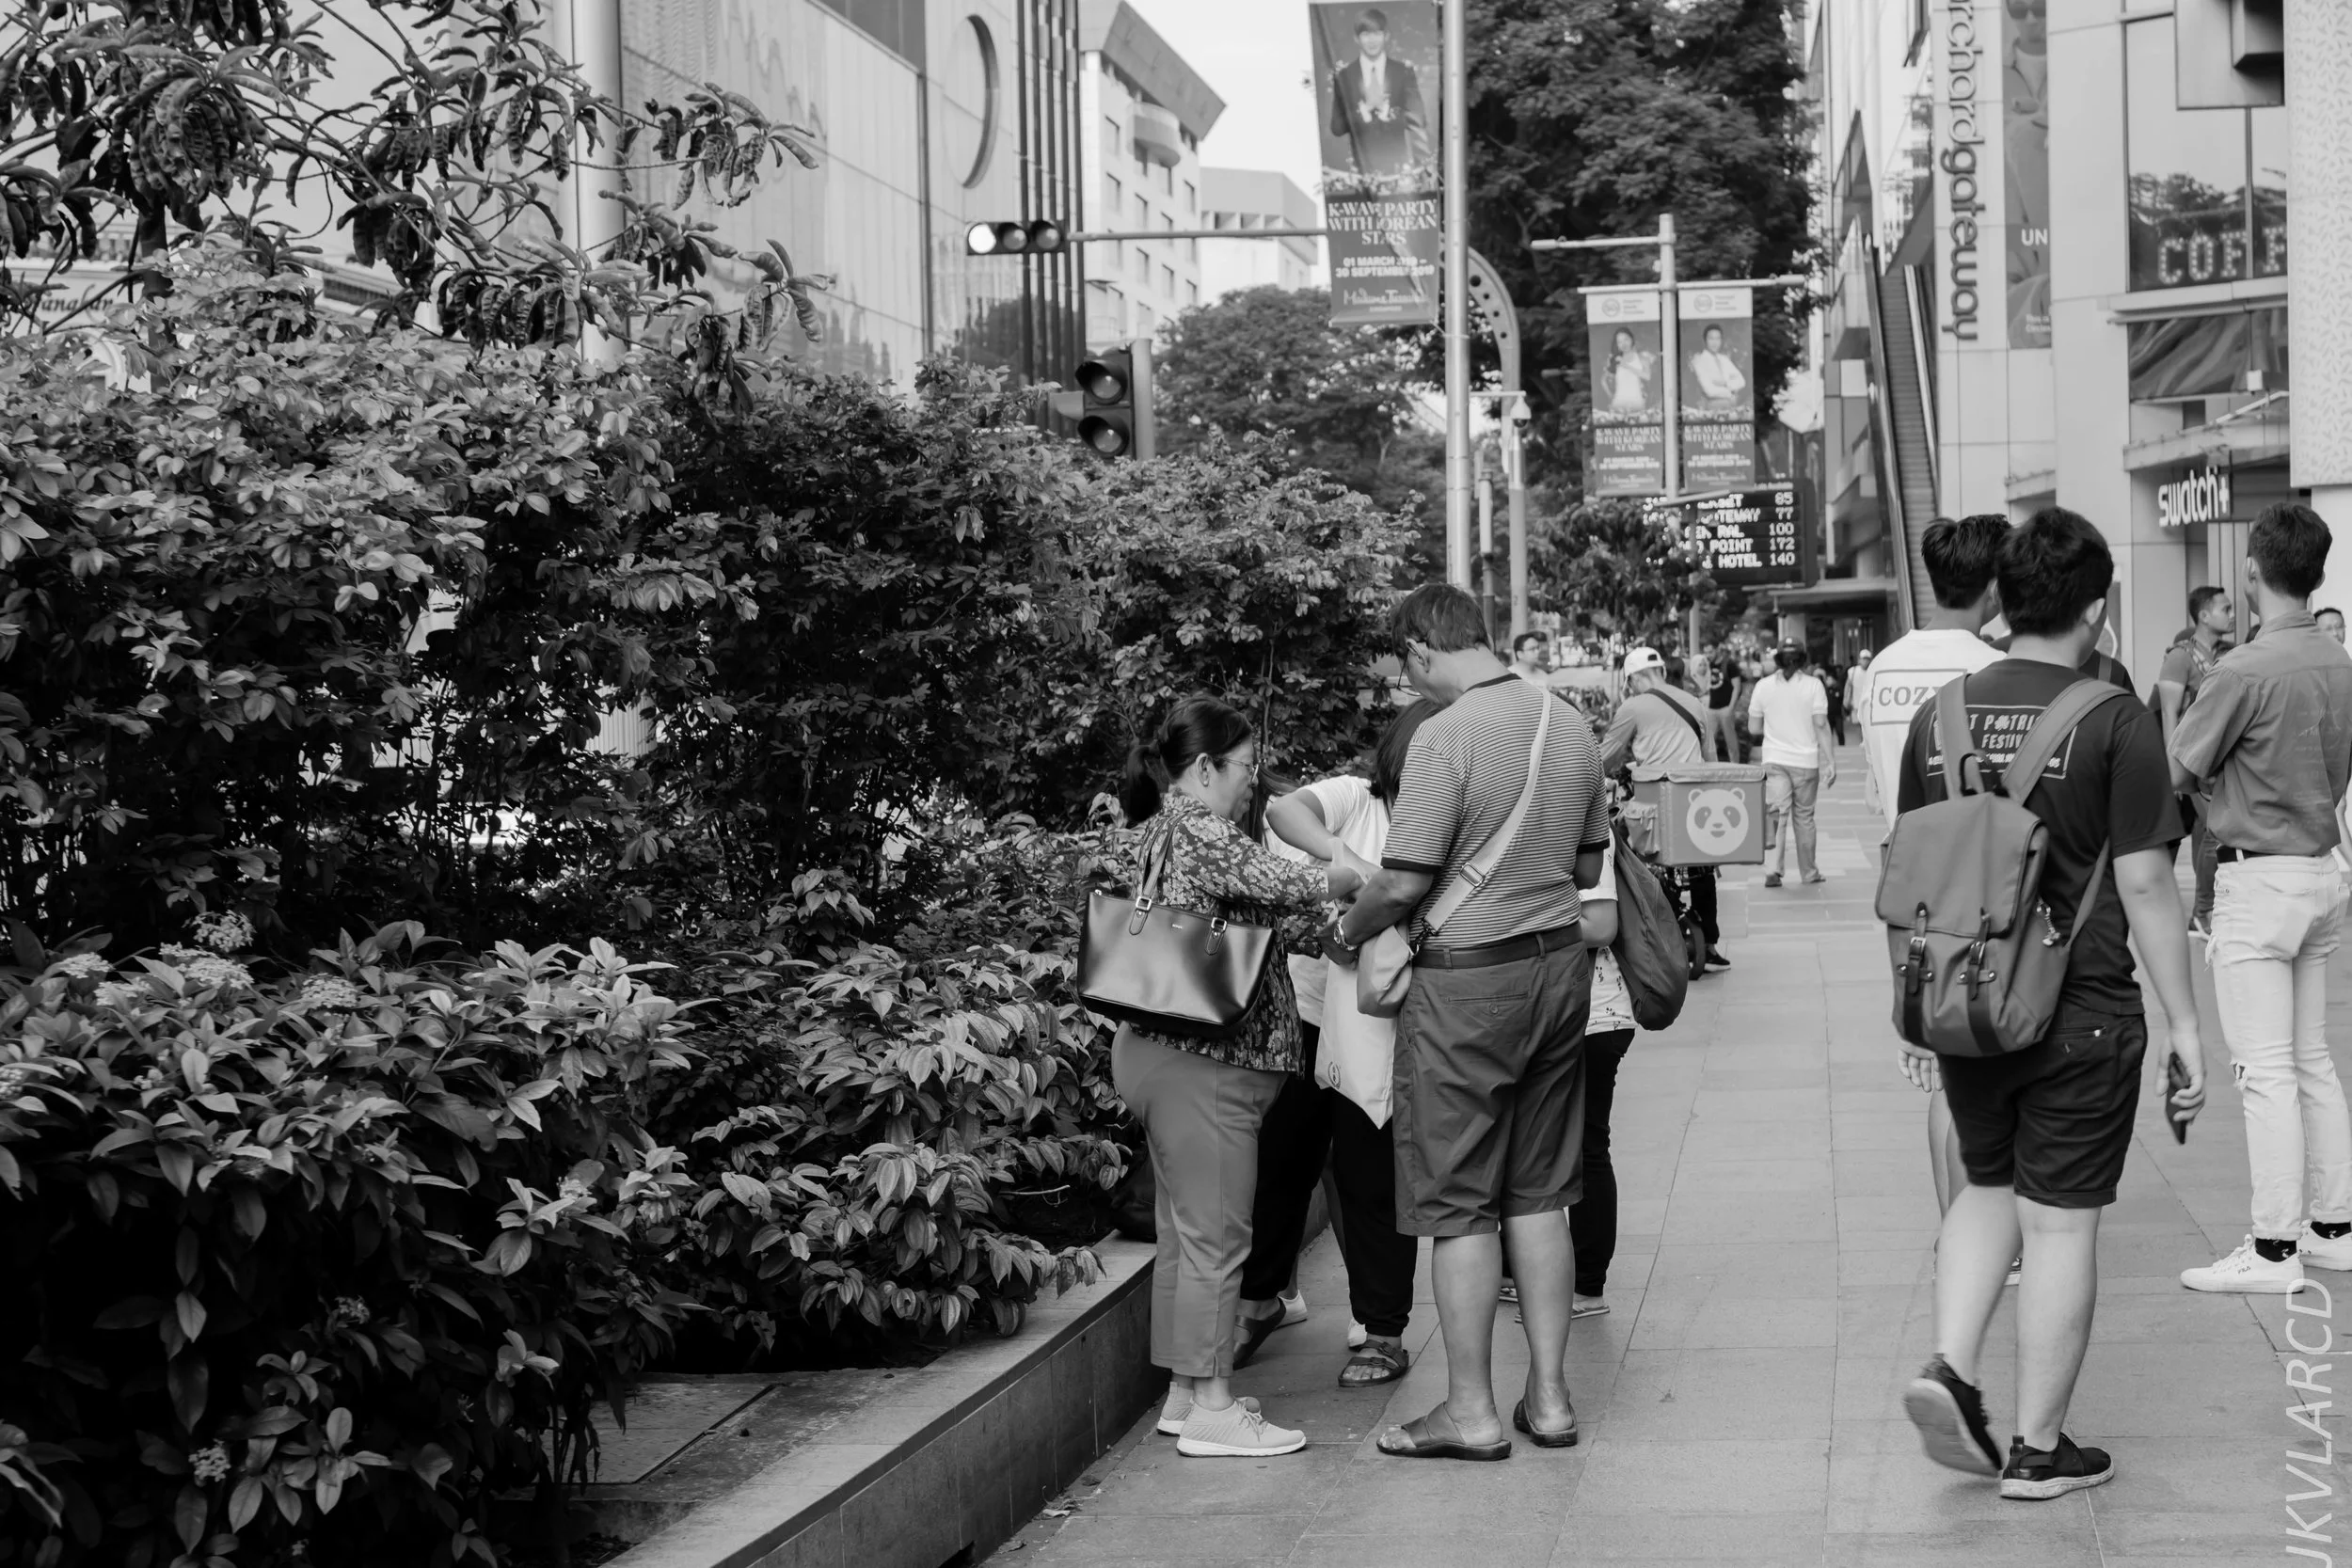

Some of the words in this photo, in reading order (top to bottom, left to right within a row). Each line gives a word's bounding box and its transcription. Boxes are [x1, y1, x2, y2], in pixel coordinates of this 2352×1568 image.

[1940, 0, 1986, 341] rchardgateway
[1384, 198, 1438, 216] PARTY
[1328, 215, 1374, 231] WITH
[1357, 256, 1395, 266] MARCH
[1774, 506, 1794, 520] 77
[1769, 521, 1795, 536] 100
[1709, 537, 1754, 554] POINT
[1769, 536, 1795, 551] 172
[1718, 552, 1762, 569] HOTEL
[1770, 551, 1796, 566] 140
[1878, 686, 1939, 706] COZ
